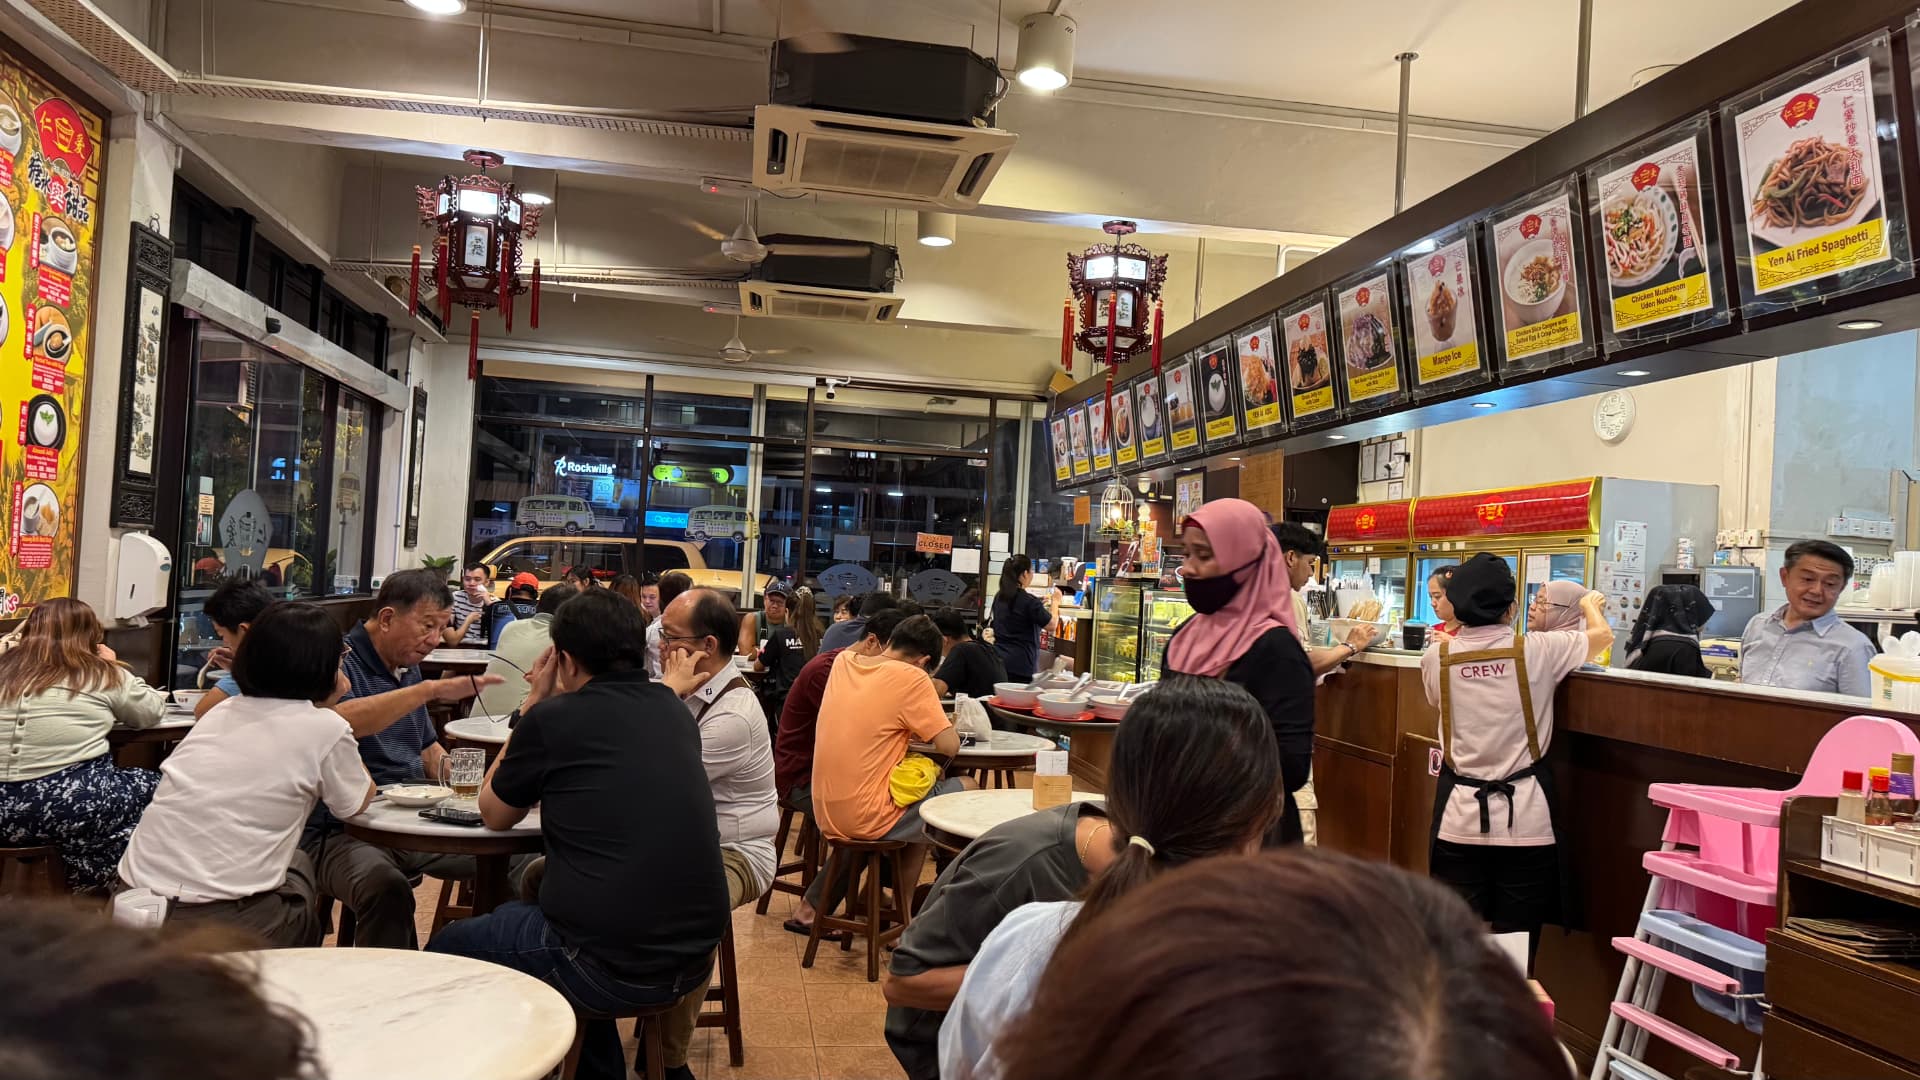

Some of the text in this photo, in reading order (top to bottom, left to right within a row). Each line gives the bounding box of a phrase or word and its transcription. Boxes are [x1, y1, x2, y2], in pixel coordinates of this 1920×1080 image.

[1767, 229, 1869, 268] Yen Ai Fried Spaghetti
[1631, 283, 1686, 304] Chicken Mushroom
[1640, 294, 1678, 310] Udon Noodle
[1432, 350, 1462, 367] Mango Ice
[567, 462, 613, 475] Rockwills
[918, 541, 950, 550] CLOSED
[1460, 663, 1506, 678] CREW
